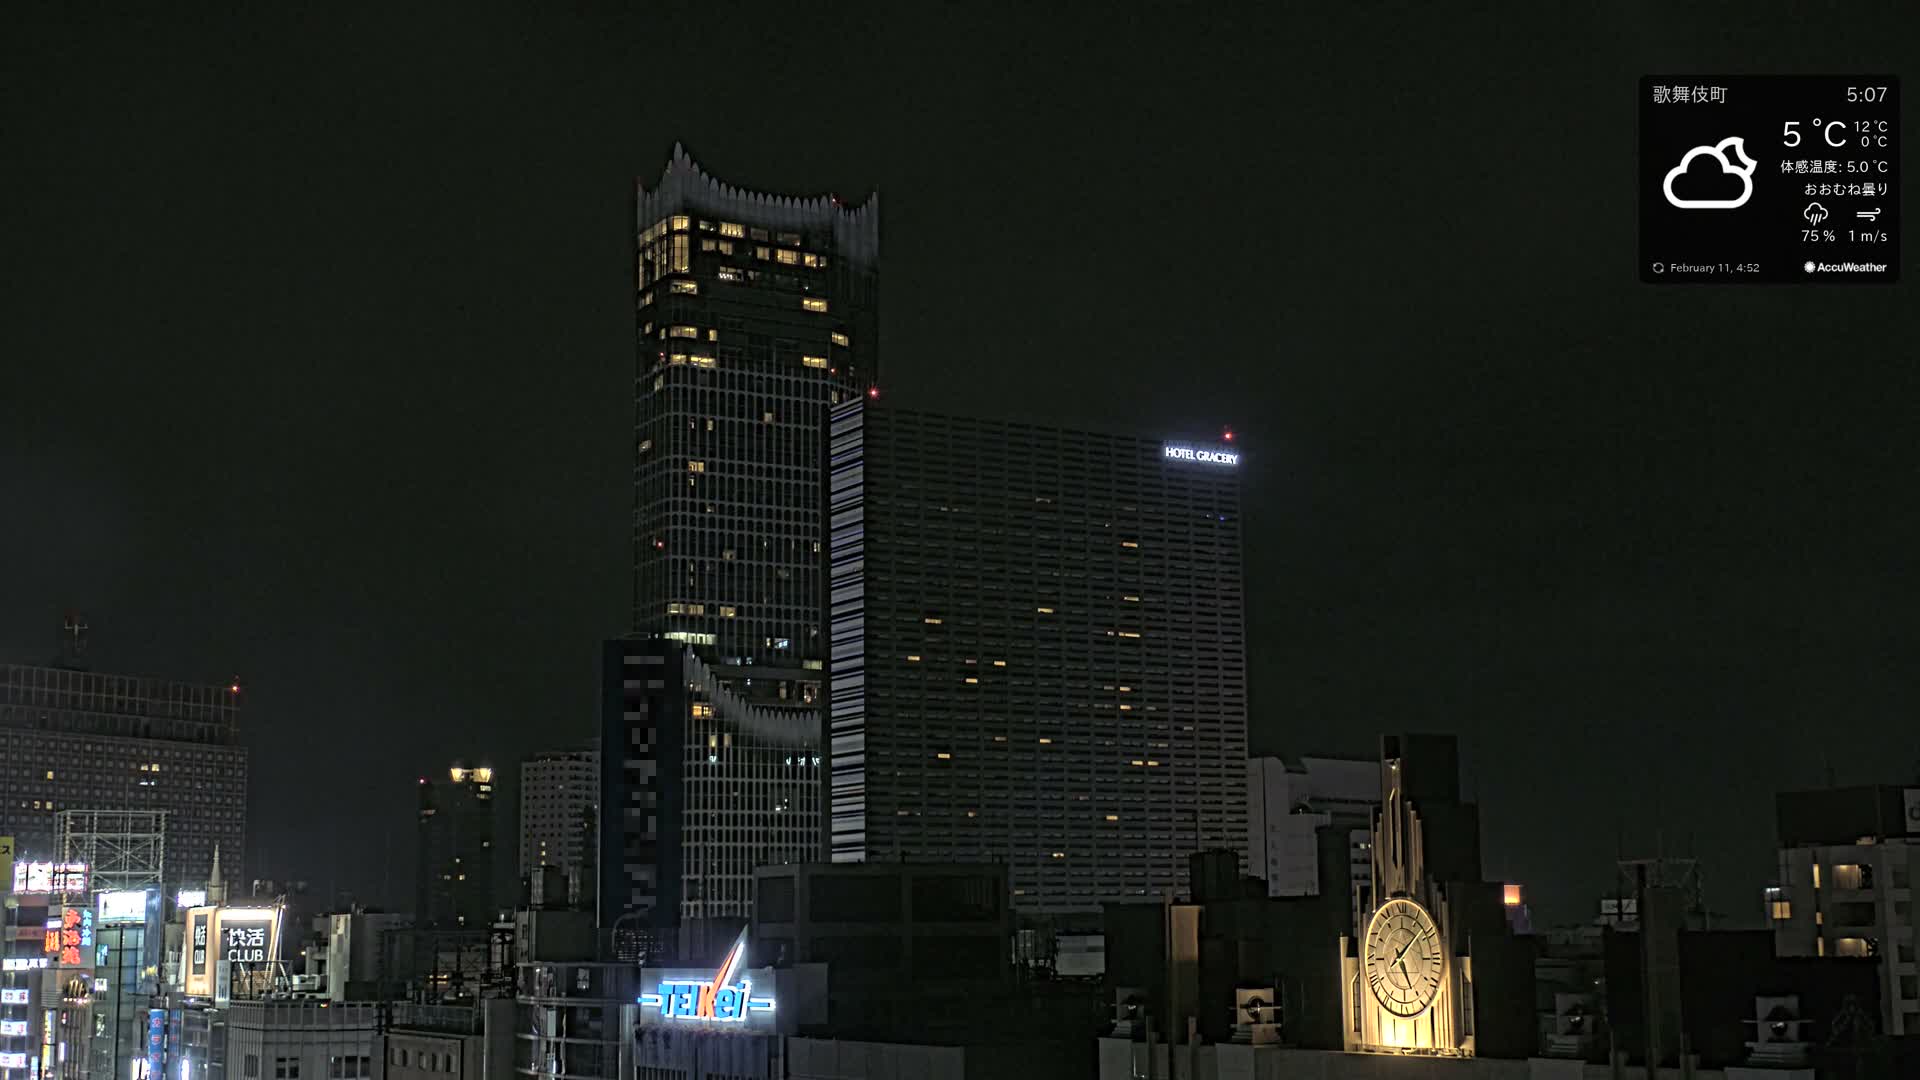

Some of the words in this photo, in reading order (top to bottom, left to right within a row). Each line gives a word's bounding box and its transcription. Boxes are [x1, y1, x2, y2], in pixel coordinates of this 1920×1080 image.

[1165, 447, 1195, 460] HOTEL
[1196, 451, 1238, 464] GRACERY
[228, 949, 264, 962] CLUB
